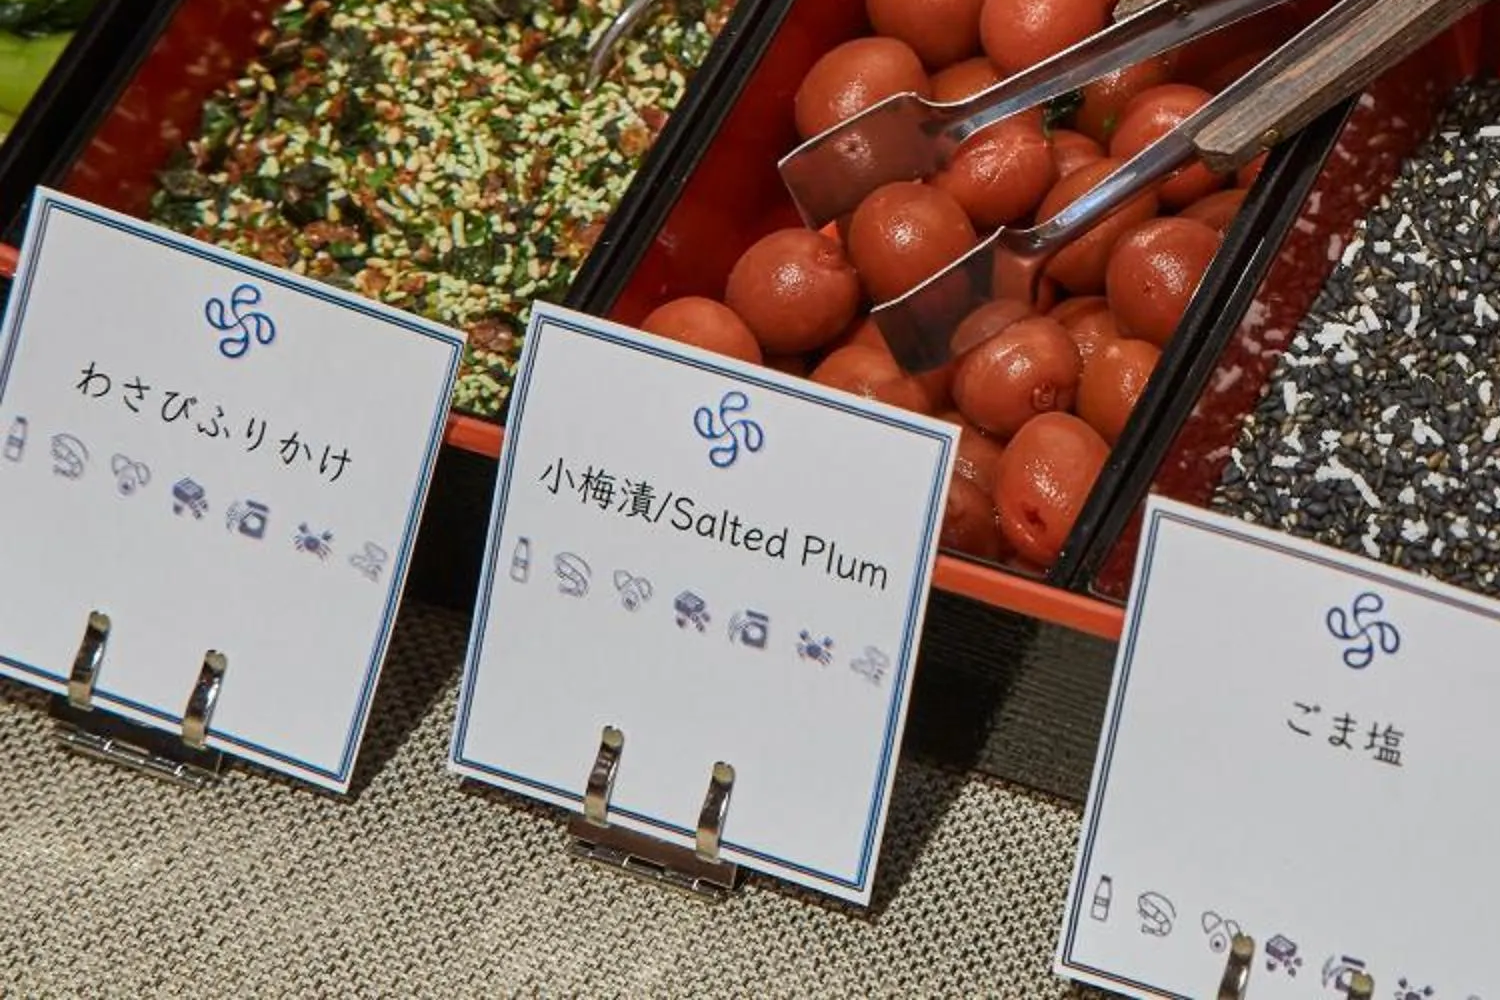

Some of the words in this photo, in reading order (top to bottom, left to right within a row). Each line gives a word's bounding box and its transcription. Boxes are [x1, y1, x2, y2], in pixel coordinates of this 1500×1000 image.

[75, 361, 353, 483] わさびふりかけ
[801, 534, 889, 591] Plum
[1286, 701, 1405, 767] ごま塩
